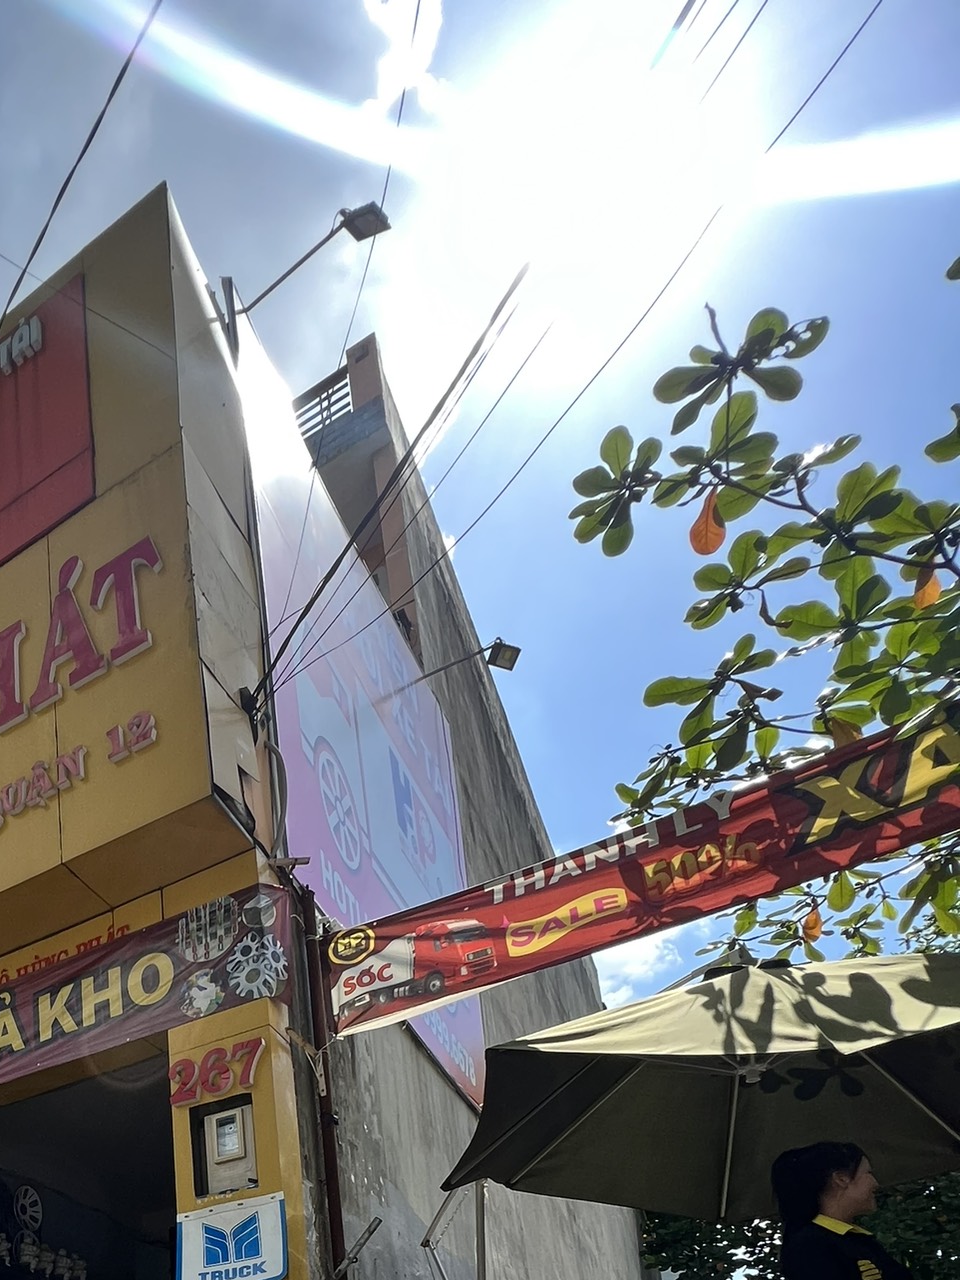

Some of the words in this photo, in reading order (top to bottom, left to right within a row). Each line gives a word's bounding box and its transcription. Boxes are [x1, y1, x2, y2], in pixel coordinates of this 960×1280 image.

[106, 711, 158, 763] 12
[485, 822, 660, 904] THANH
[510, 894, 621, 948] SALE
[38, 952, 175, 1042] KHO
[342, 963, 394, 996] SỐC
[169, 1037, 266, 1108] 267
